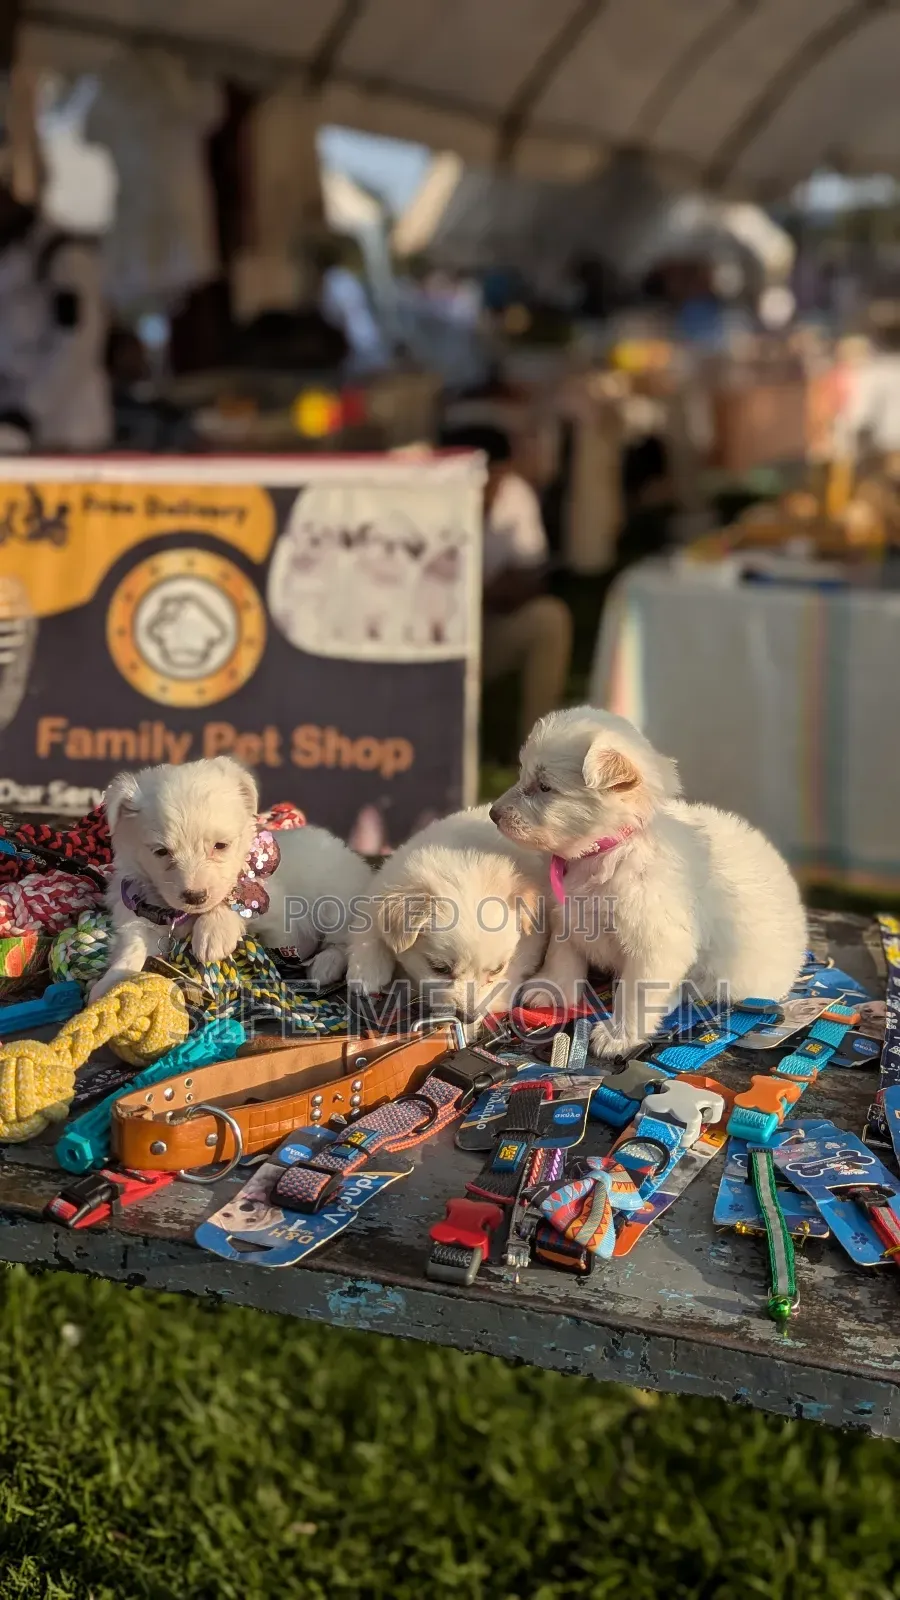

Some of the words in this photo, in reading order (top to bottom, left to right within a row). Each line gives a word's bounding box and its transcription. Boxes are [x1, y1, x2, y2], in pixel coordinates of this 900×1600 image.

[36, 715, 193, 766] Family
[203, 720, 283, 768] Pet
[291, 722, 414, 780] Shop
[47, 779, 104, 811] Serv
[268, 1228, 315, 1244] D&H
